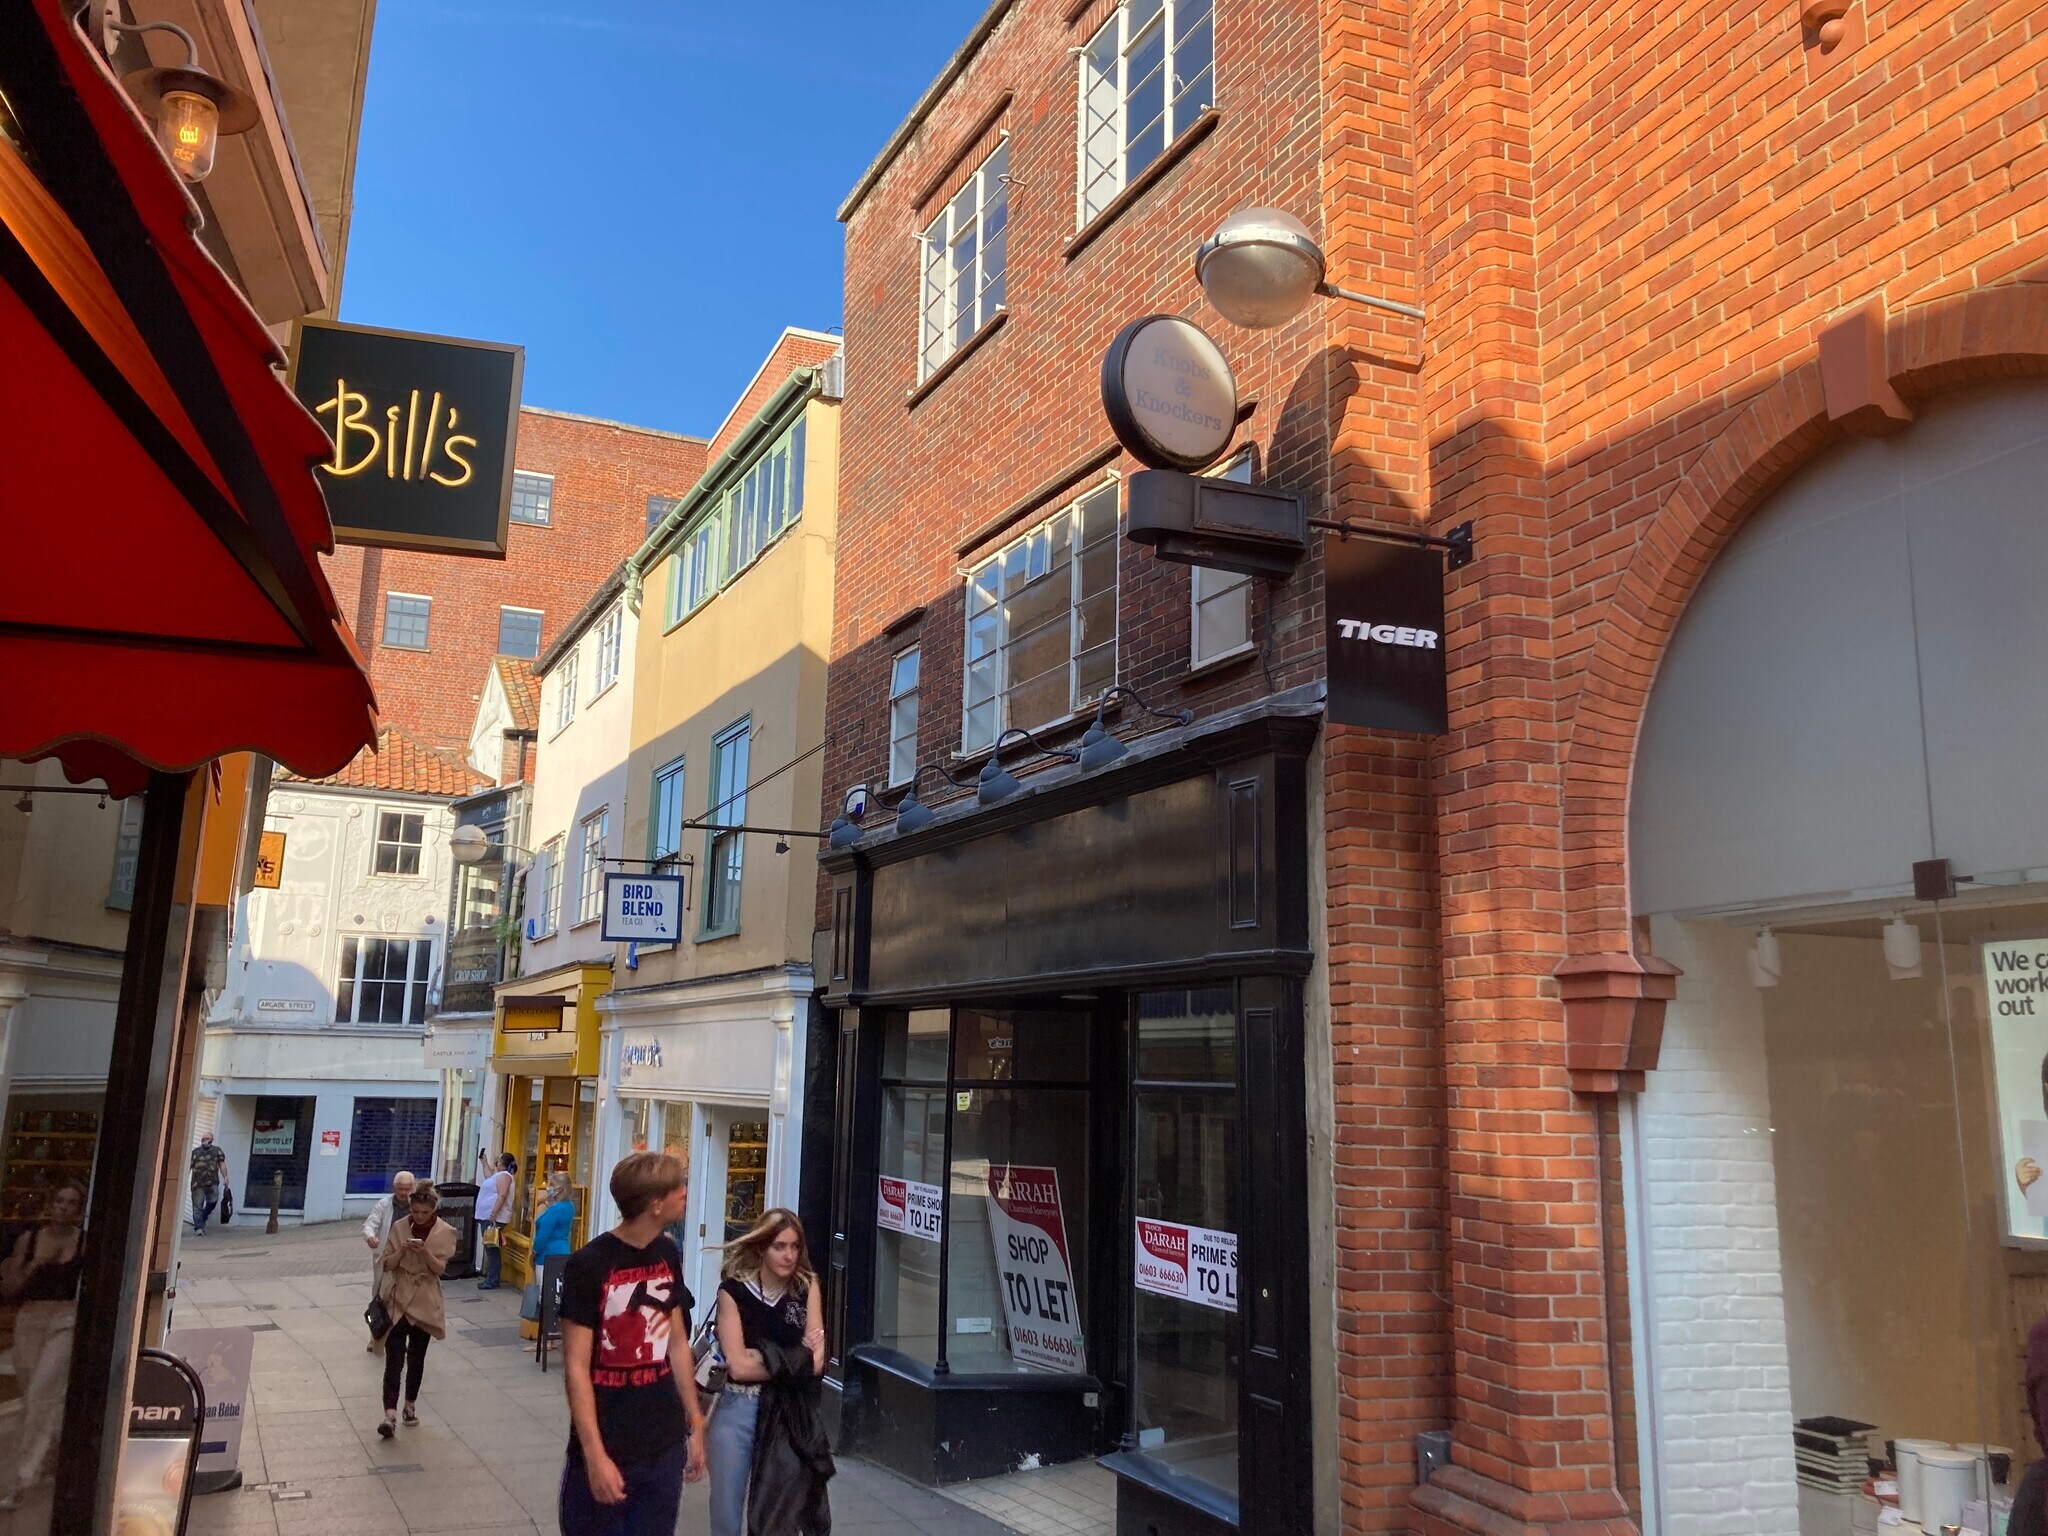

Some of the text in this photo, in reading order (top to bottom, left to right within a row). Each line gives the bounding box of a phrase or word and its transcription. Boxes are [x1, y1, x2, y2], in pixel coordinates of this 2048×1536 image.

[1153, 346, 1210, 380] Knobs
[1174, 377, 1191, 398] &
[1135, 388, 1222, 431] Knockers
[315, 378, 477, 487] Bill's
[1336, 618, 1439, 650] TIGER
[623, 884, 653, 900] BIRD
[622, 901, 663, 917] BLEND
[622, 918, 633, 926] TEA
[1991, 951, 2048, 972] We c
[455, 969, 488, 982] CROP SHOP
[260, 1002, 287, 1010] ARCADE
[1998, 996, 2036, 1017] out
[883, 1185, 905, 1198] DARRAH
[907, 1193, 926, 1208] PRIME
[910, 1209, 922, 1228] TO
[924, 1213, 941, 1233] LET
[1008, 1234, 1049, 1264] SHOP
[1145, 1230, 1185, 1251] DARRAH
[1213, 1236, 1220, 1244] TO
[1192, 1244, 1227, 1266] PRIME
[1139, 1263, 1184, 1284] 01603 666630
[1197, 1267, 1220, 1294] TO
[1003, 1271, 1070, 1324] TO LET
[1013, 1326, 1039, 1347] 01603
[217, 1401, 240, 1418] Bébé
